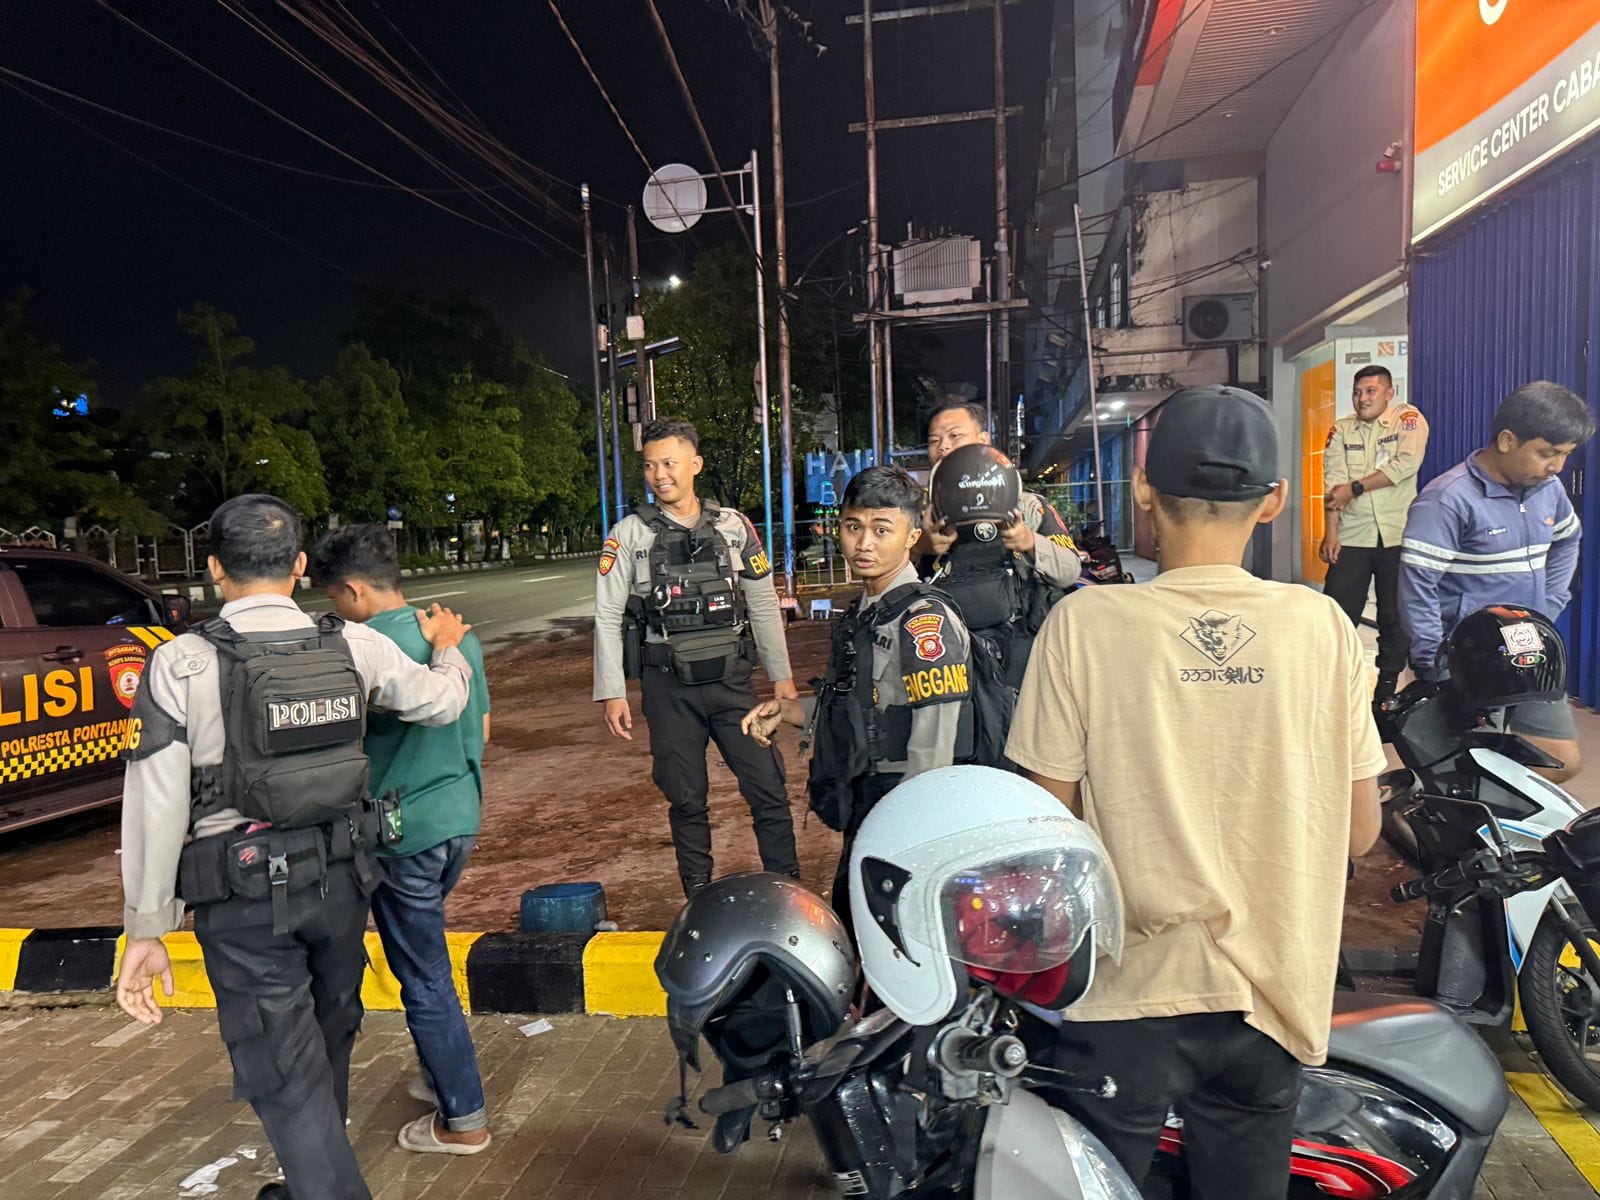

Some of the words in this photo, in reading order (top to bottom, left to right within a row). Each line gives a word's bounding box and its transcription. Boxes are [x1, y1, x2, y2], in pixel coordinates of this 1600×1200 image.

[1437, 136, 1489, 197] SERVICE
[1490, 92, 1550, 159] CENTER
[902, 663, 969, 703] ENGGANG
[272, 695, 357, 728] POLISI
[1, 729, 71, 758] POLRESTA
